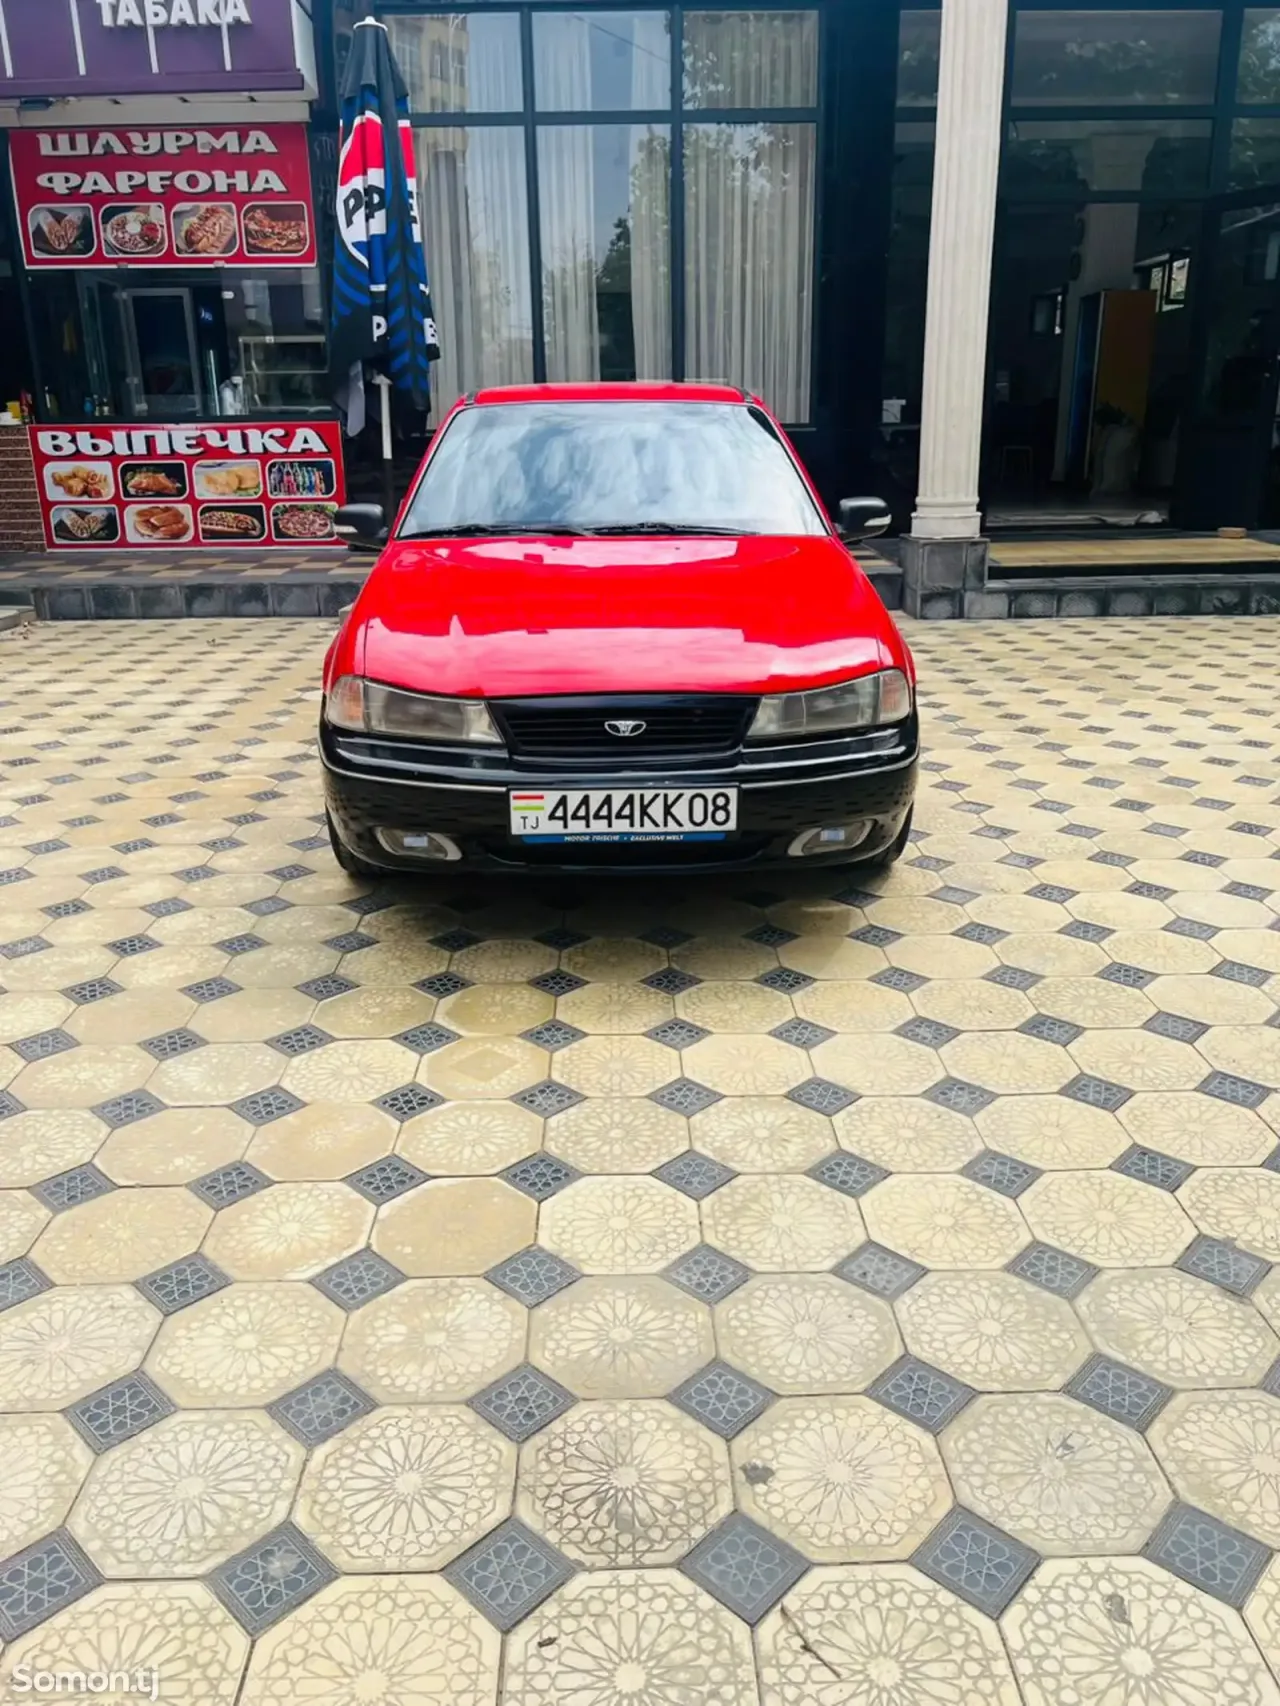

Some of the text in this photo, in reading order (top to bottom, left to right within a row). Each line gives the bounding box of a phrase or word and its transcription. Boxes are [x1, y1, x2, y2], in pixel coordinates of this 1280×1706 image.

[96, 0, 252, 27] ТАБАКА
[37, 428, 328, 456] ВЫПЕЧКА
[520, 816, 539, 829] TJ
[547, 791, 731, 829] 4444KK08
